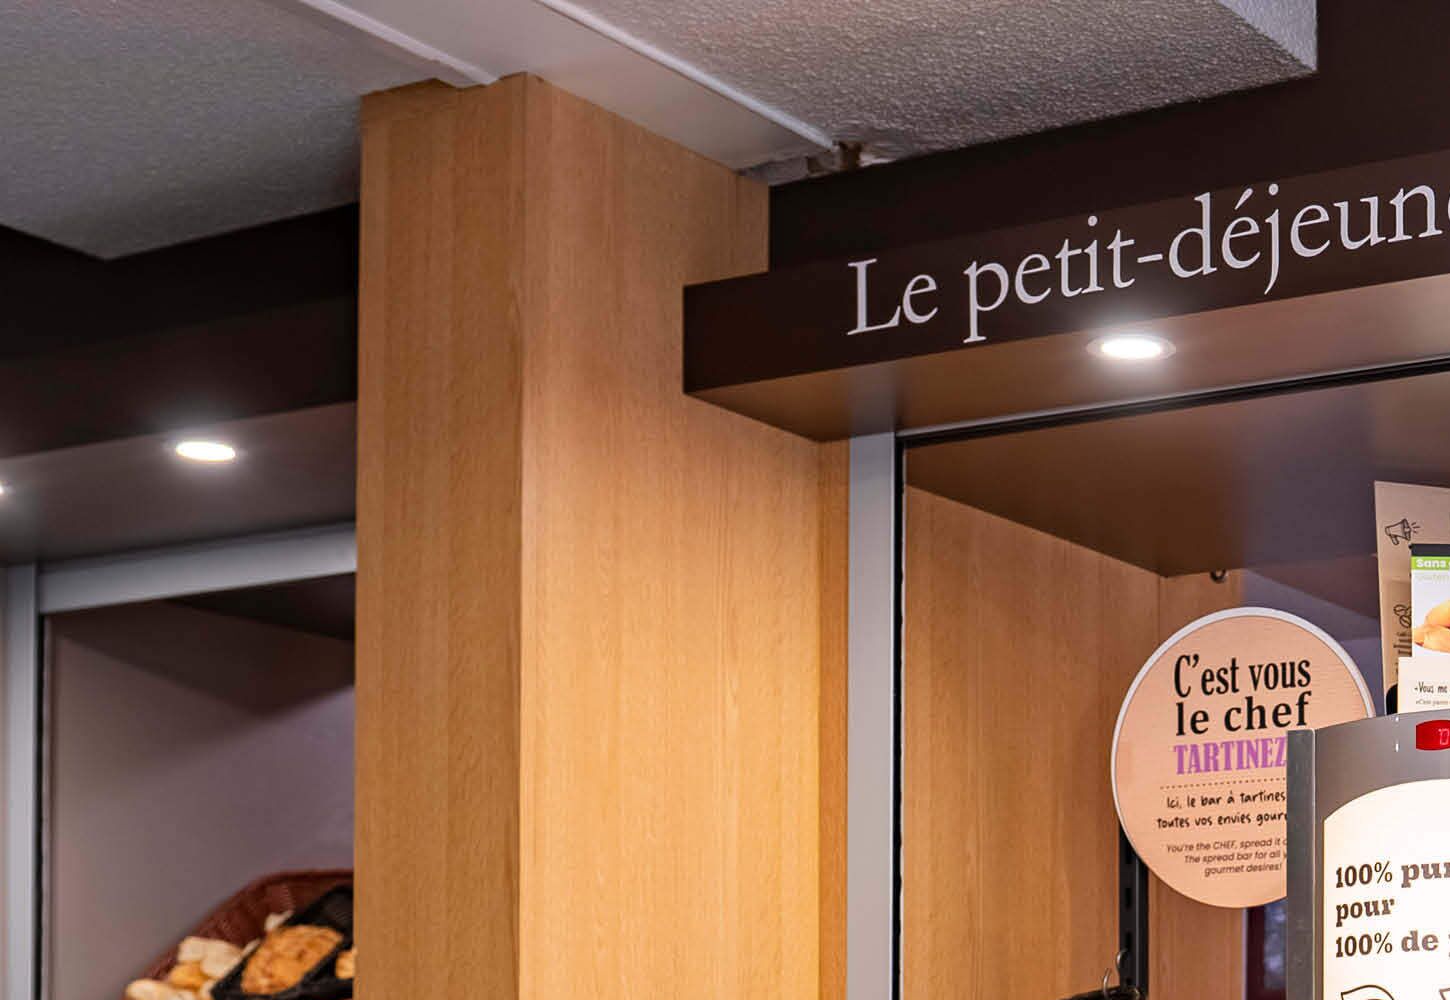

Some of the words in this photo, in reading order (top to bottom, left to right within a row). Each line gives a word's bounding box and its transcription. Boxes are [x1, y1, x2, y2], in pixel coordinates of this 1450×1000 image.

[847, 258, 938, 335] Le
[1416, 558, 1446, 569] Sans
[1249, 659, 1312, 693] vous
[1175, 702, 1209, 736] le
[1224, 691, 1312, 732] chef
[1173, 736, 1286, 775] TARTINEZ
[1187, 796, 1196, 808] le
[1201, 795, 1222, 807] bar
[1227, 790, 1235, 804] à
[1240, 790, 1286, 803] tartines
[1157, 816, 1190, 828] toutes
[1195, 815, 1213, 826] vos
[1217, 812, 1251, 825] envies
[1336, 861, 1393, 888] 100%
[1336, 898, 1395, 927] pour
[1336, 932, 1393, 958] 100%
[1401, 930, 1439, 952] de
